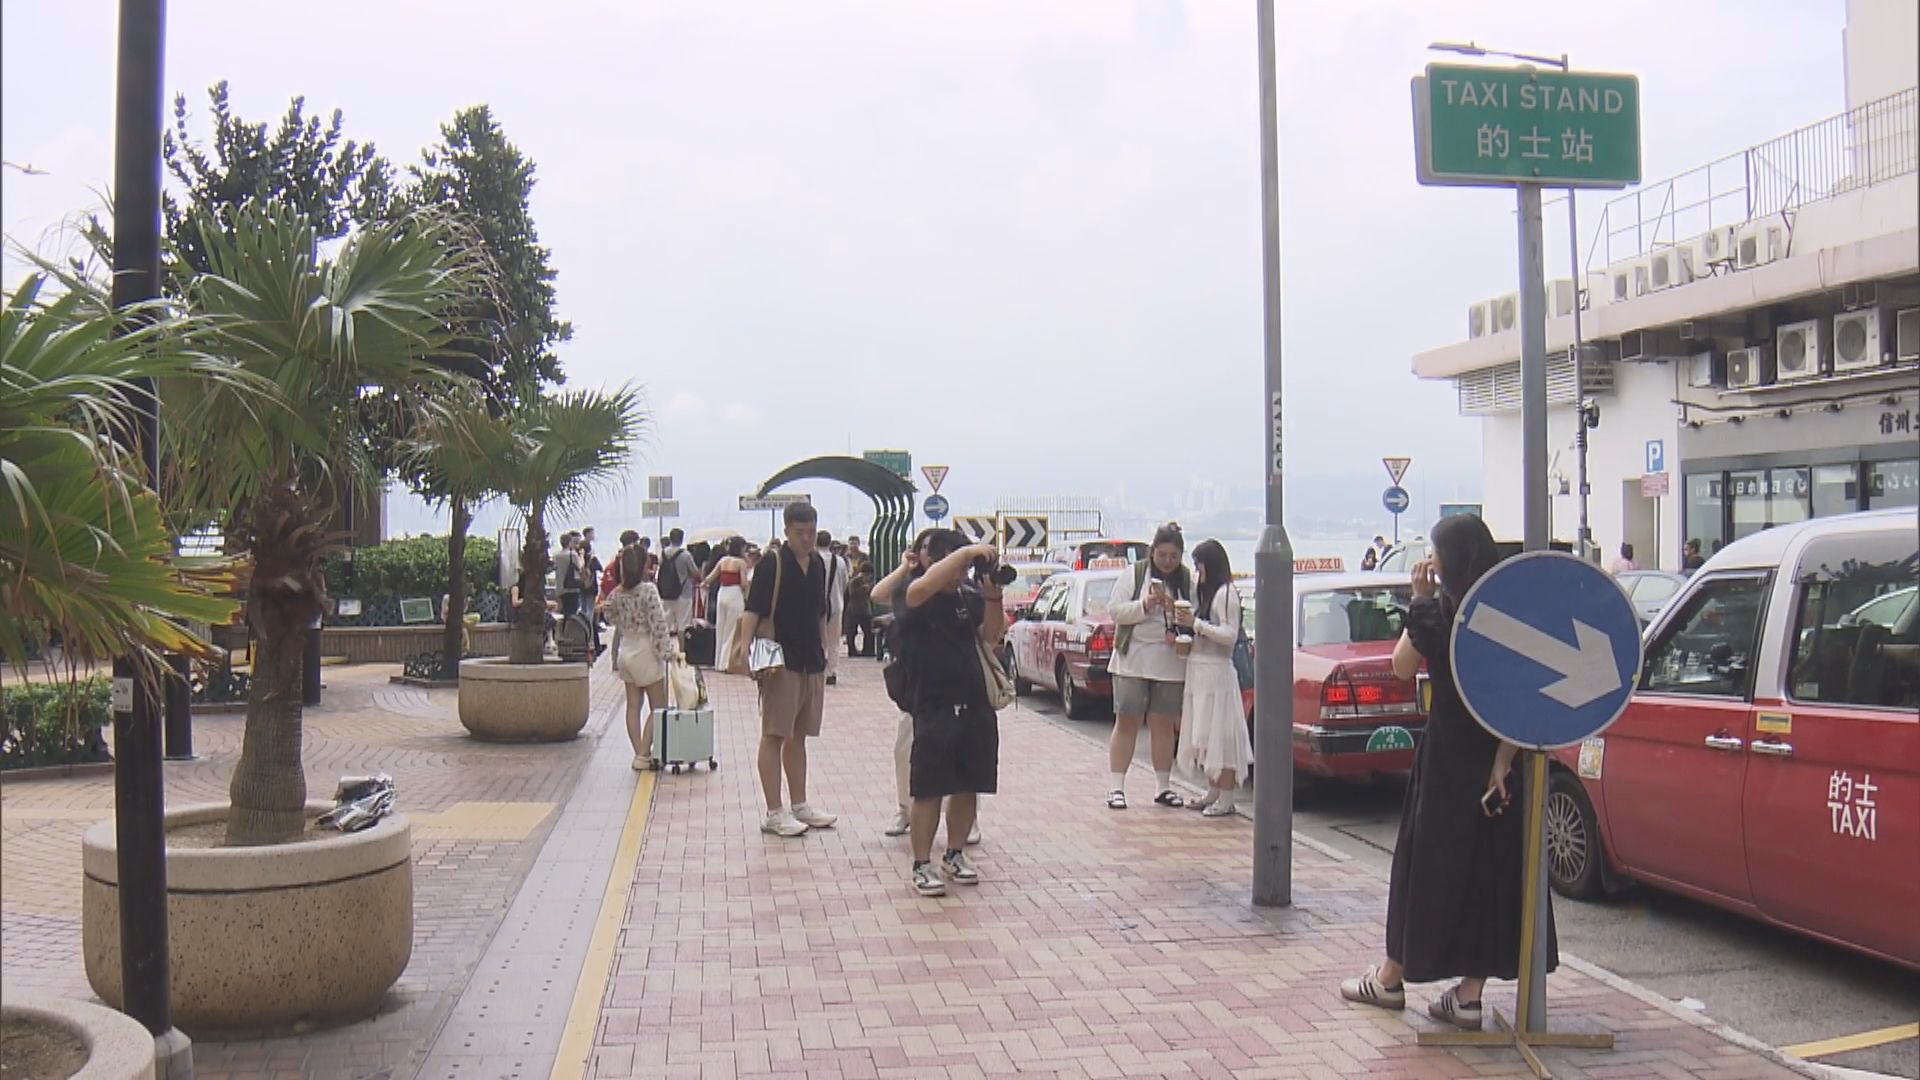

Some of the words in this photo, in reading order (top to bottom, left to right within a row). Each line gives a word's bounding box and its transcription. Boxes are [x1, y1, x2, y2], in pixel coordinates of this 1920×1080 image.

[1441, 79, 1508, 108] TAXI
[1519, 83, 1624, 114] STAND
[1476, 122, 1594, 163] 的士站
[1648, 442, 1661, 471] P
[1294, 558, 1341, 571] TAXI
[1828, 770, 1878, 807] 的士
[1827, 801, 1876, 841] TAXI
